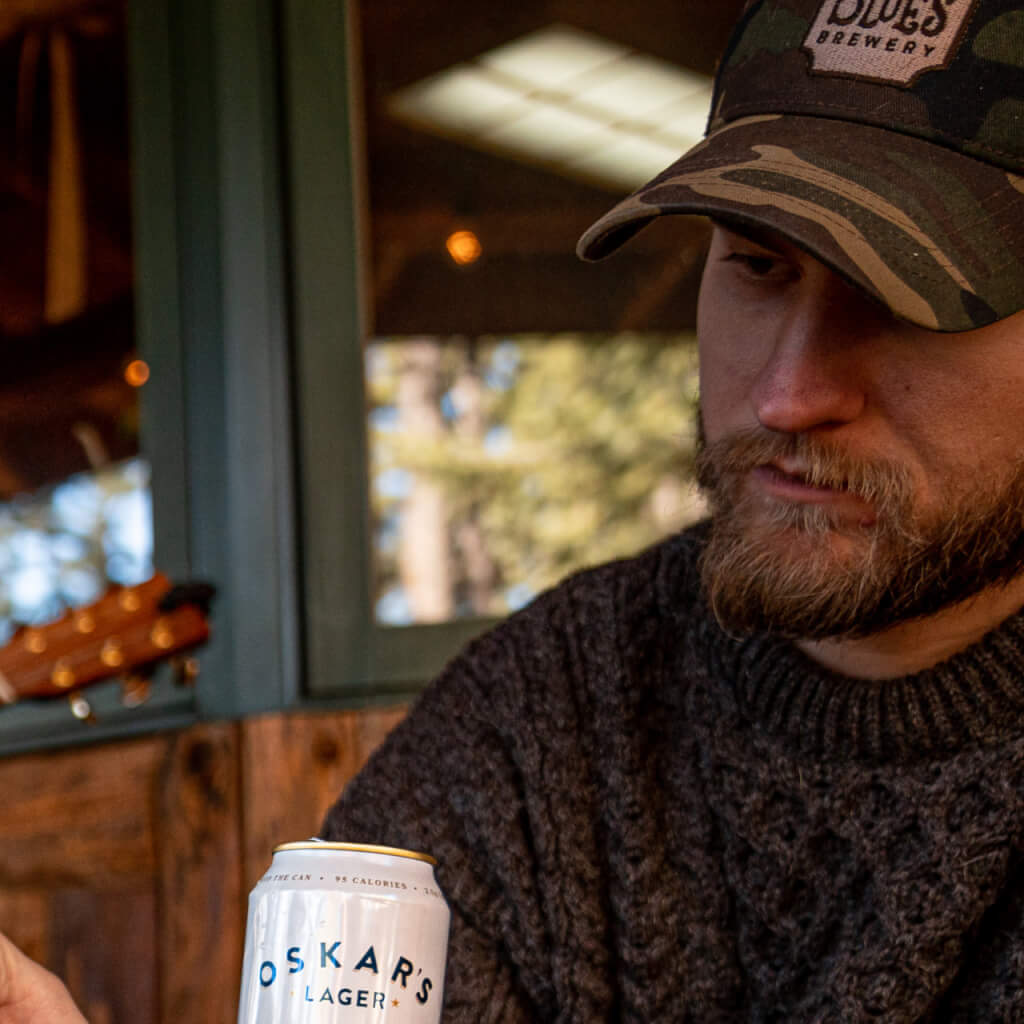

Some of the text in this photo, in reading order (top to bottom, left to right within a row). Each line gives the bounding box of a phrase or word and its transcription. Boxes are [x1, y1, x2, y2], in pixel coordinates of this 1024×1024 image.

[816, 30, 937, 57] BREWERY
[352, 876, 408, 890] CALORIES
[259, 941, 433, 1005] OSKAR'S
[305, 985, 386, 1010] LAGER
